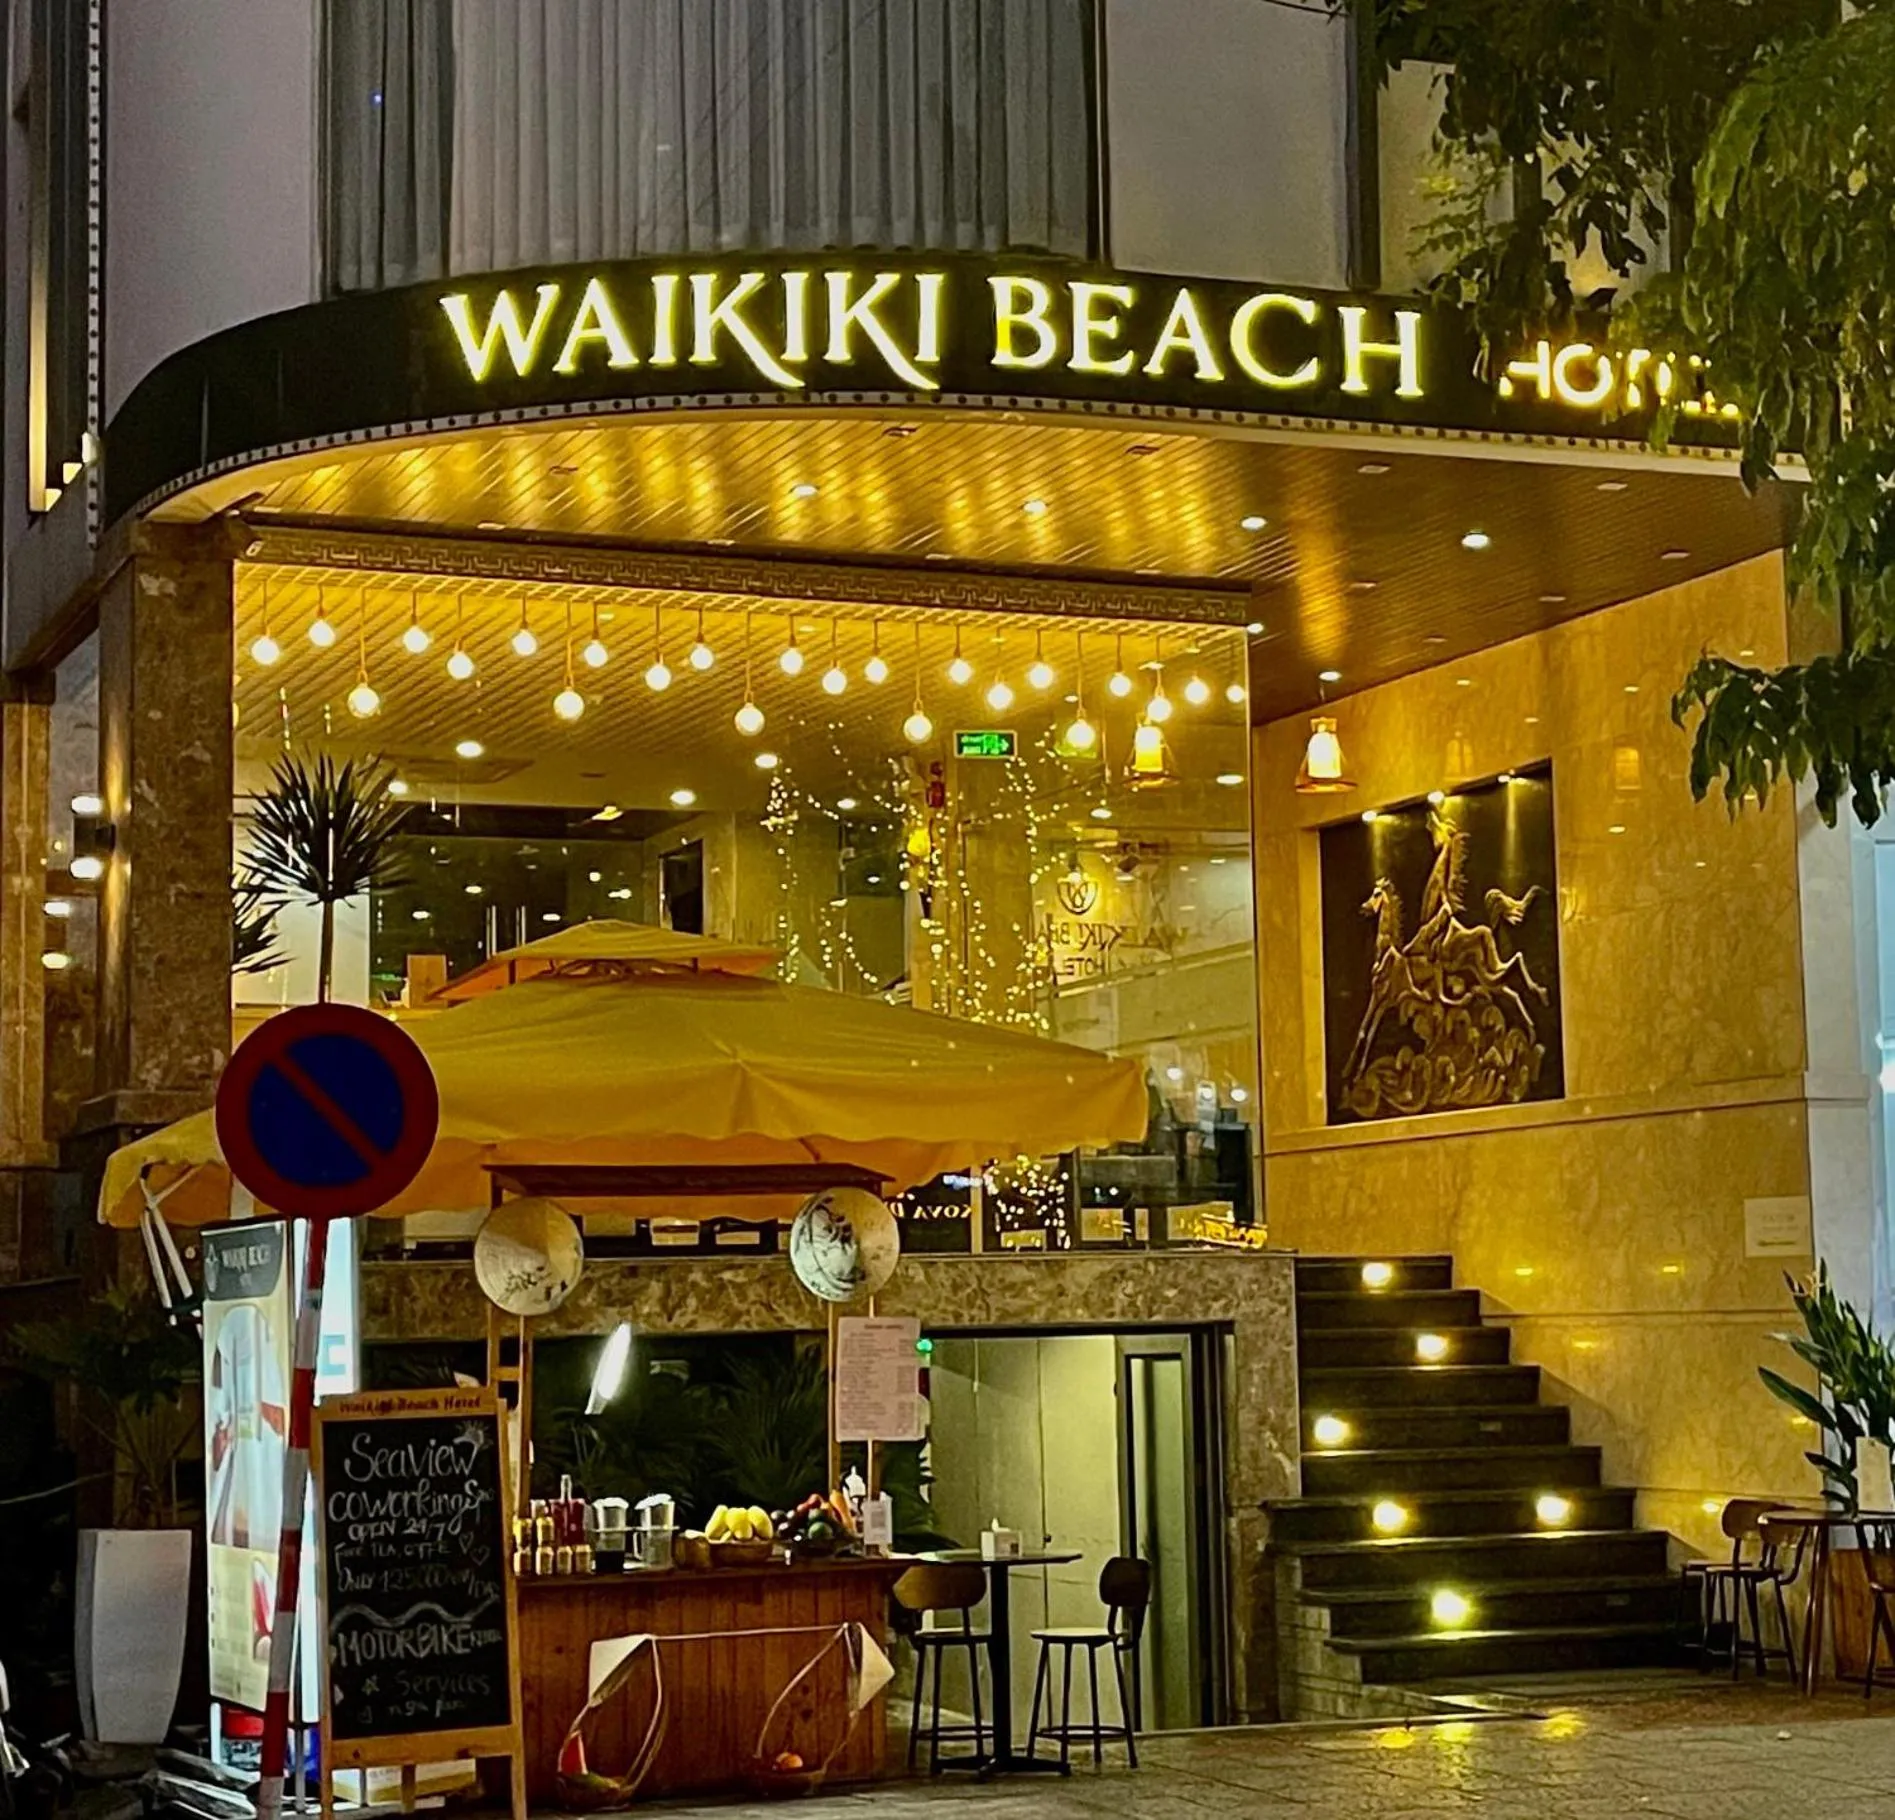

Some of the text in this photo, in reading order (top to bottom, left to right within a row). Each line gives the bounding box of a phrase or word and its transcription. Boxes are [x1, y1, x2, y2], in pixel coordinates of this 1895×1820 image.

[438, 270, 944, 390] WAIKIKI
[987, 275, 1425, 397] BEACH
[395, 1669, 491, 1697] Services
